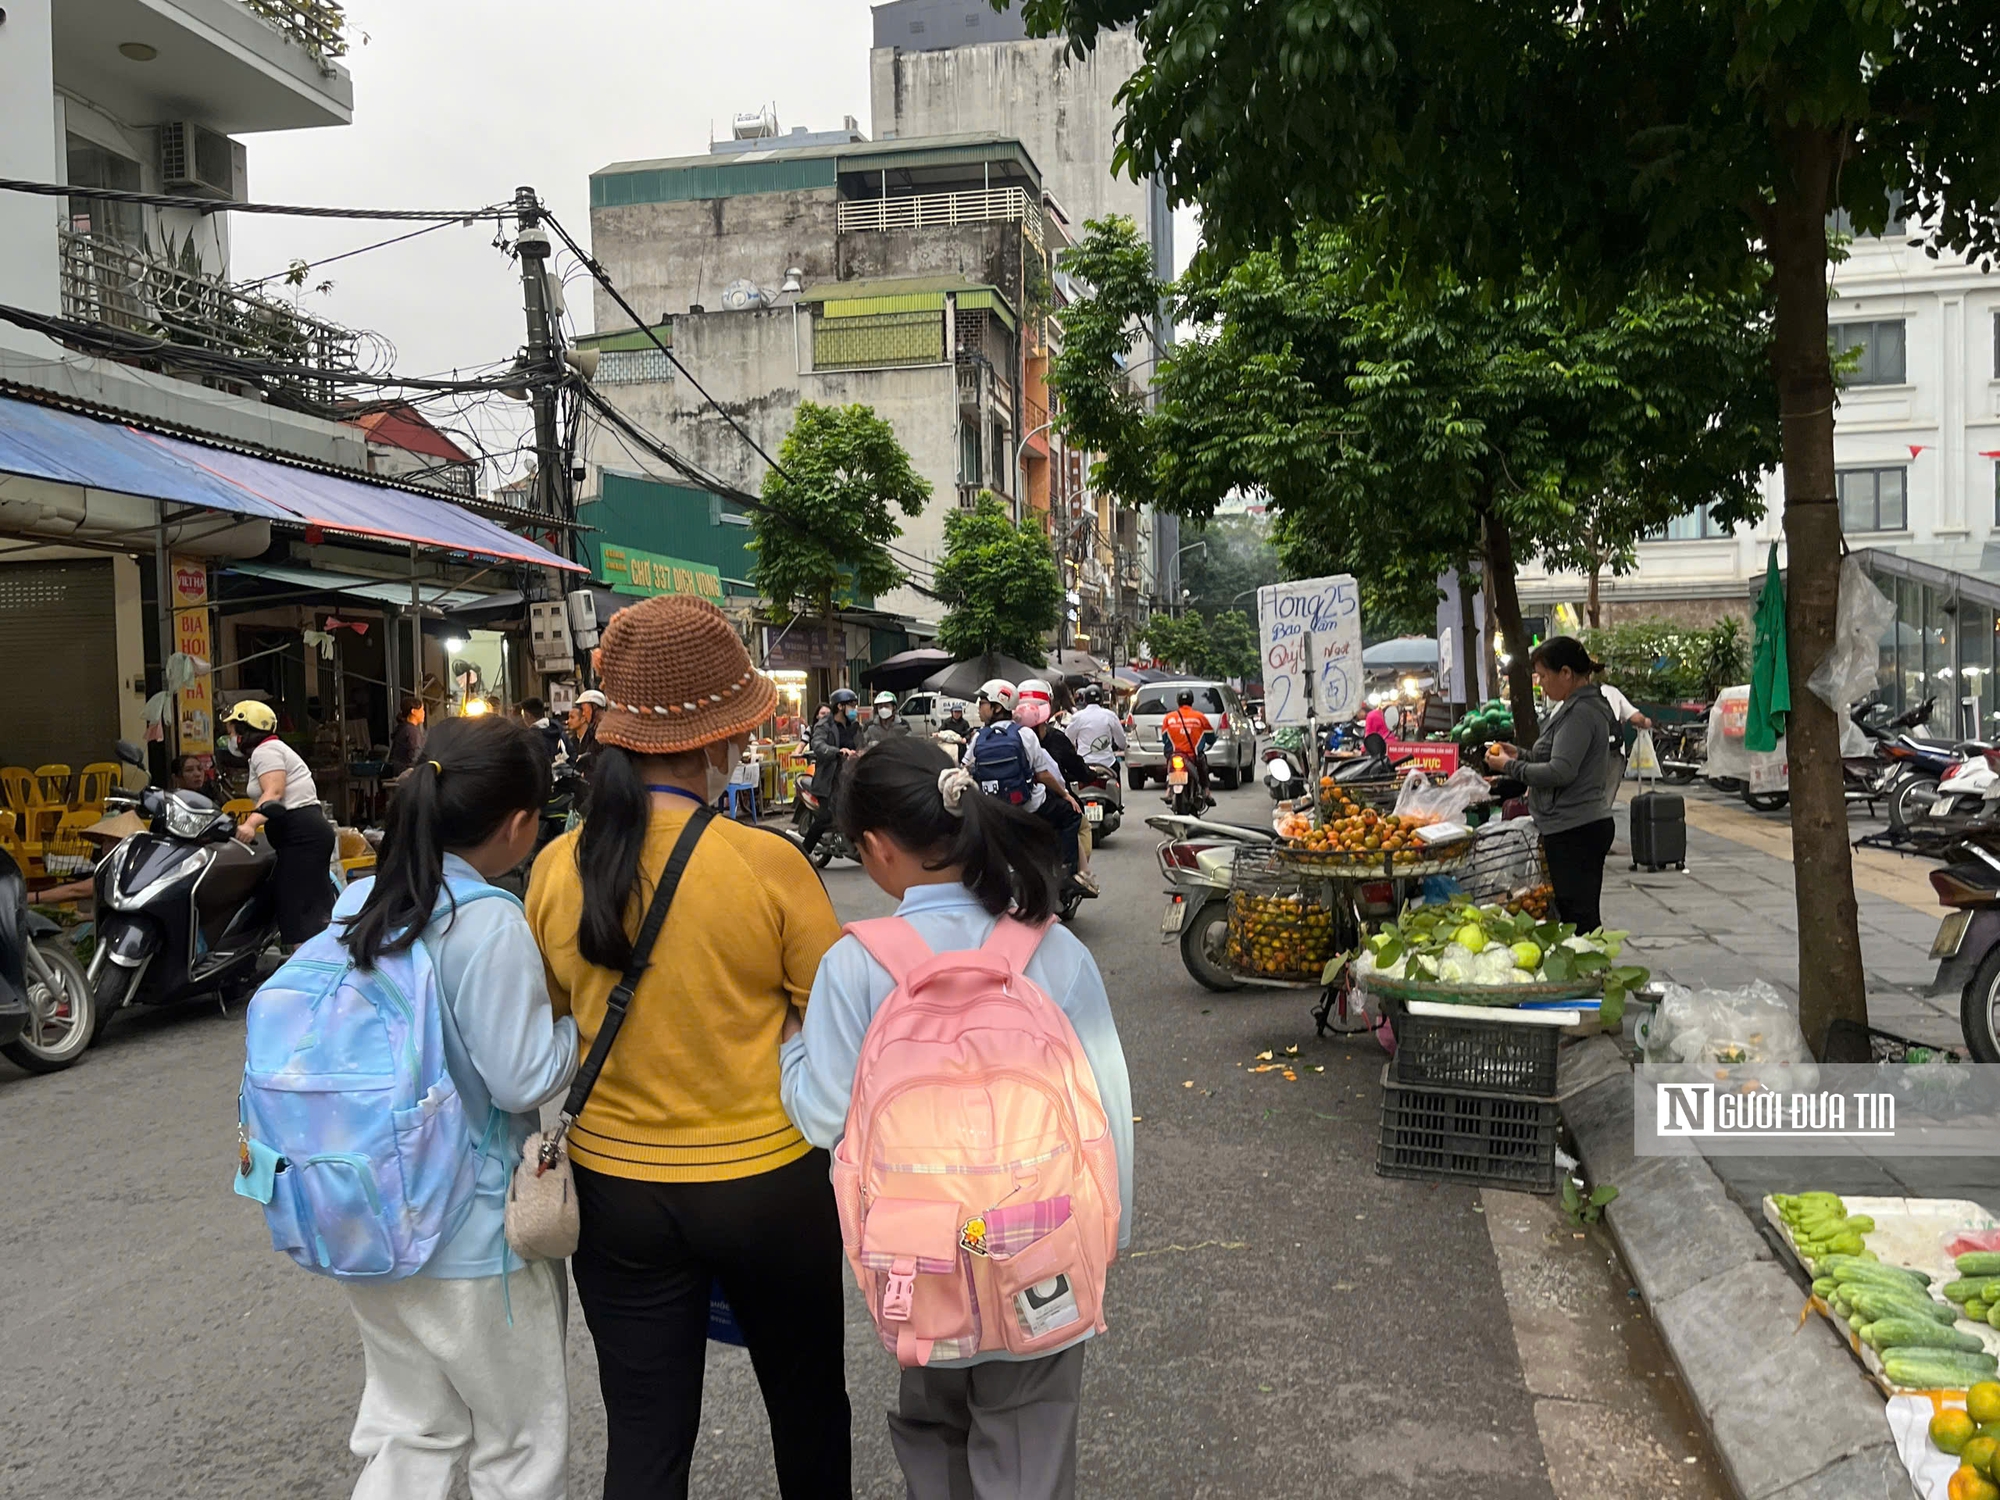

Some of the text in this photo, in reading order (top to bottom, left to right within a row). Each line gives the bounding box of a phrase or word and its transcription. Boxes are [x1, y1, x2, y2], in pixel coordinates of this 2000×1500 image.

[653, 563, 671, 590] 337
[1321, 582, 1356, 619] 25
[182, 616, 203, 633] BIA
